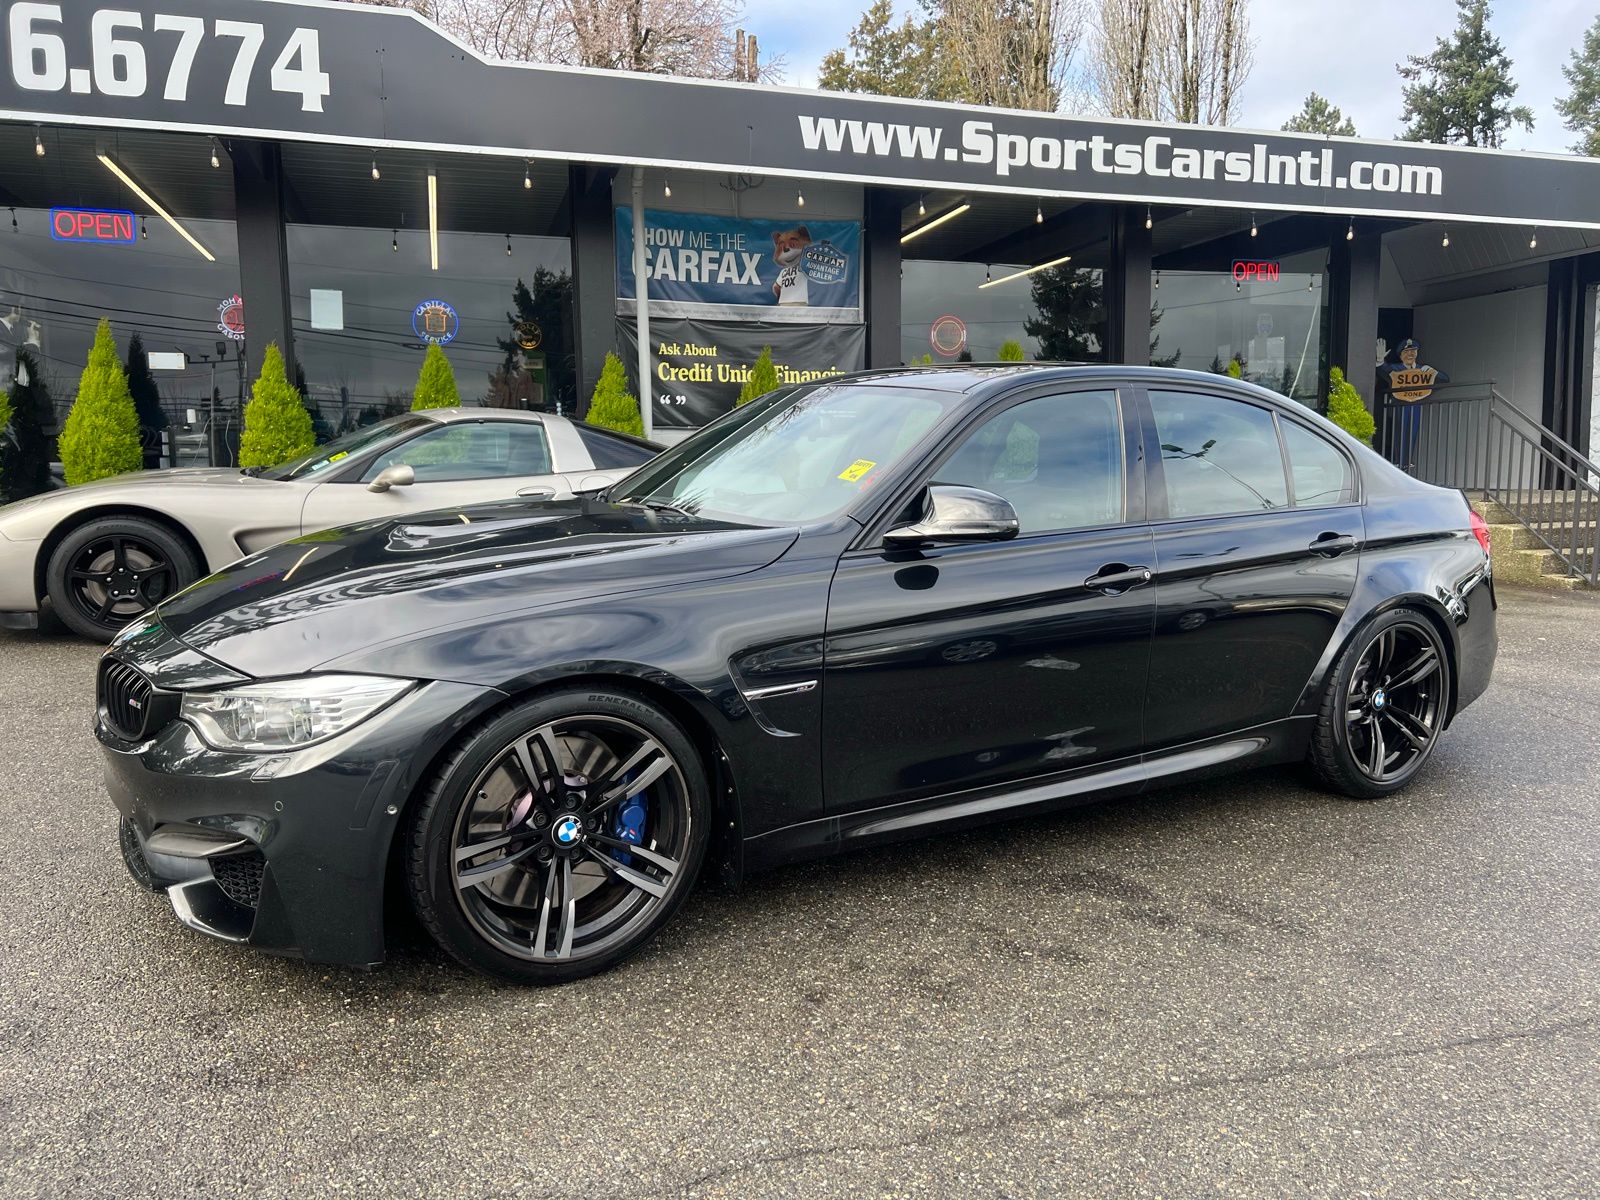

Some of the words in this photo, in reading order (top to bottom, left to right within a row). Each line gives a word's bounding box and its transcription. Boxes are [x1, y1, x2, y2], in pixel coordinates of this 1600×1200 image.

[10, 2, 331, 113] 6.6774
[798, 114, 1443, 195] www.SportsCarsIntl.com
[54, 212, 132, 240] OPEN
[632, 228, 684, 248] HOW
[689, 232, 713, 249] ME
[717, 233, 746, 251] THE
[806, 252, 845, 268] CARFAX
[782, 266, 798, 278] CAR
[806, 262, 840, 276] ADVANTAGE
[808, 270, 833, 281] DEALER
[1233, 262, 1279, 281] OPEN
[782, 277, 796, 287] FOX
[216, 297, 243, 311] MOHA
[416, 300, 456, 318] CADILLAC
[658, 342, 682, 356] Ask
[683, 343, 718, 357] About
[657, 362, 713, 382] Credit
[1397, 374, 1432, 385] SLOW
